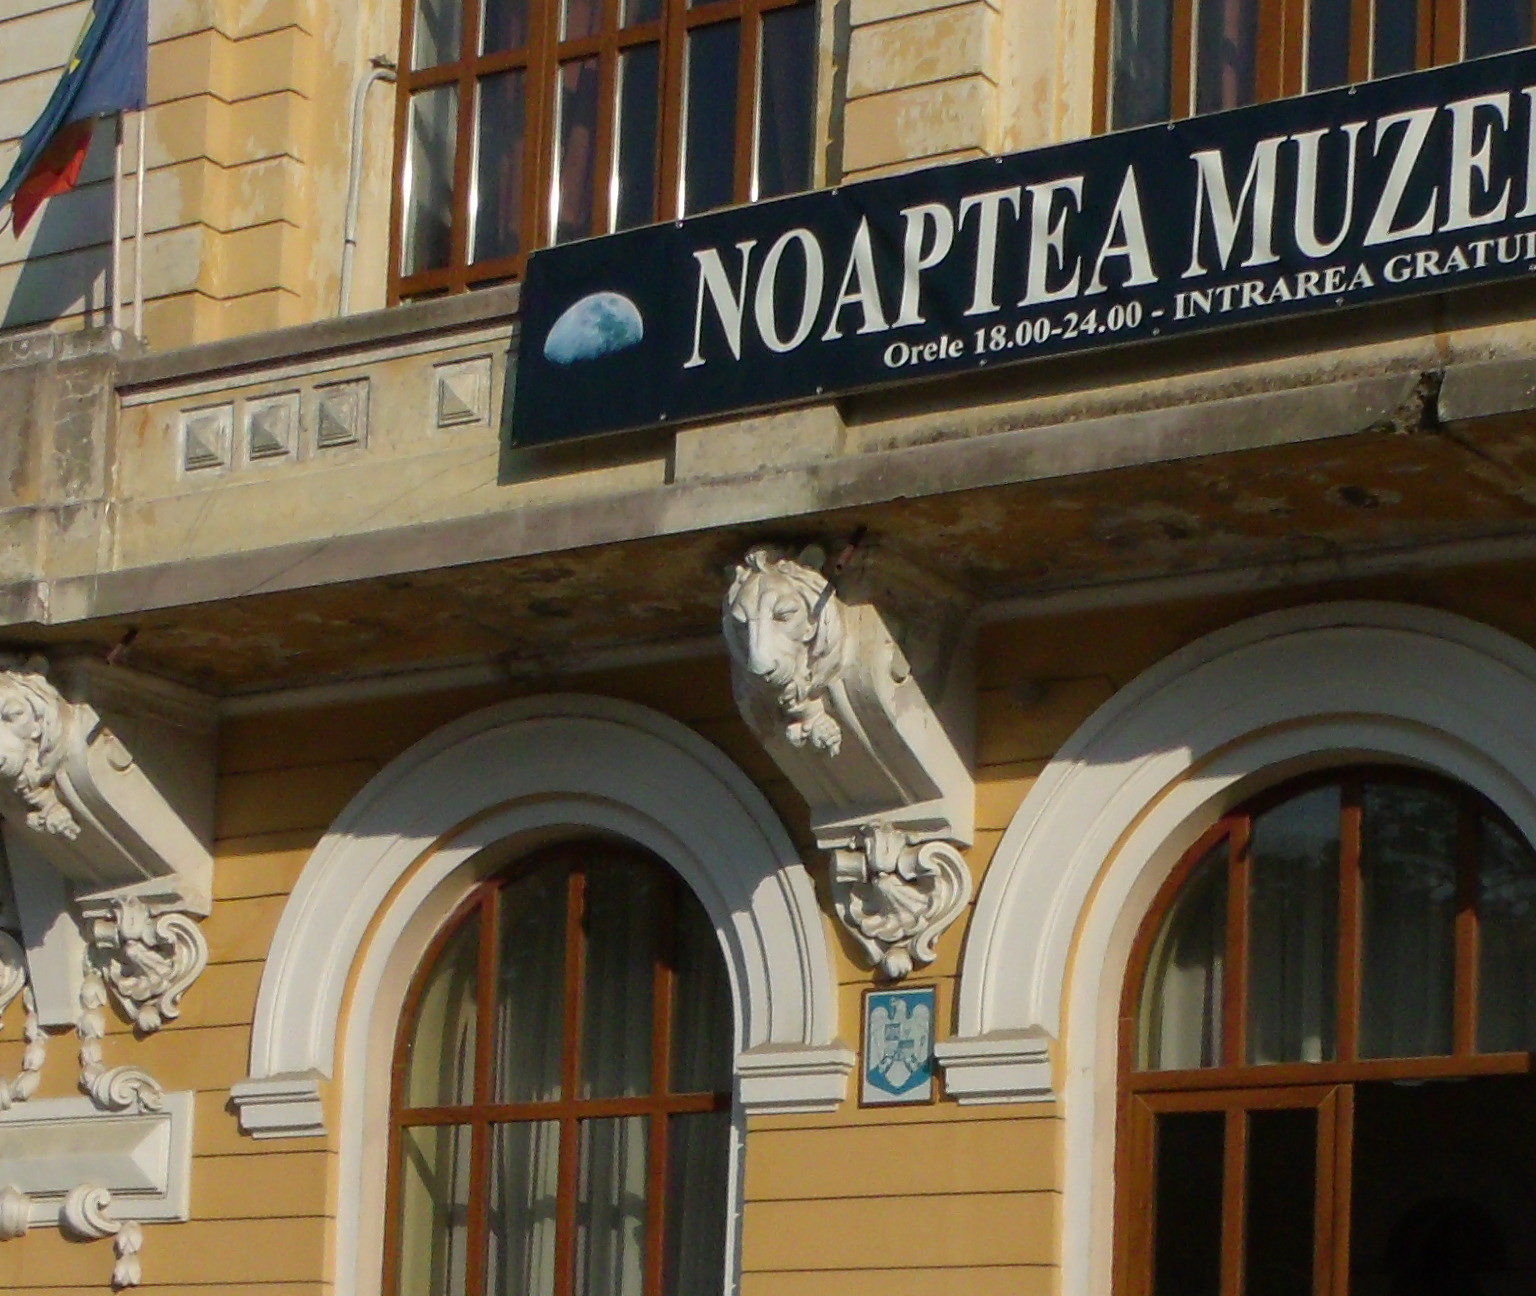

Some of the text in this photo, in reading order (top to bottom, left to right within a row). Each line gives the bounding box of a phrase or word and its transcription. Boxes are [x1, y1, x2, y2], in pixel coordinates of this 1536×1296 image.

[682, 164, 1159, 370] NOAPTEA
[882, 334, 964, 369] Orele
[974, 300, 1143, 355] 18.00-24.00
[1173, 262, 1375, 322] INTRAREA
